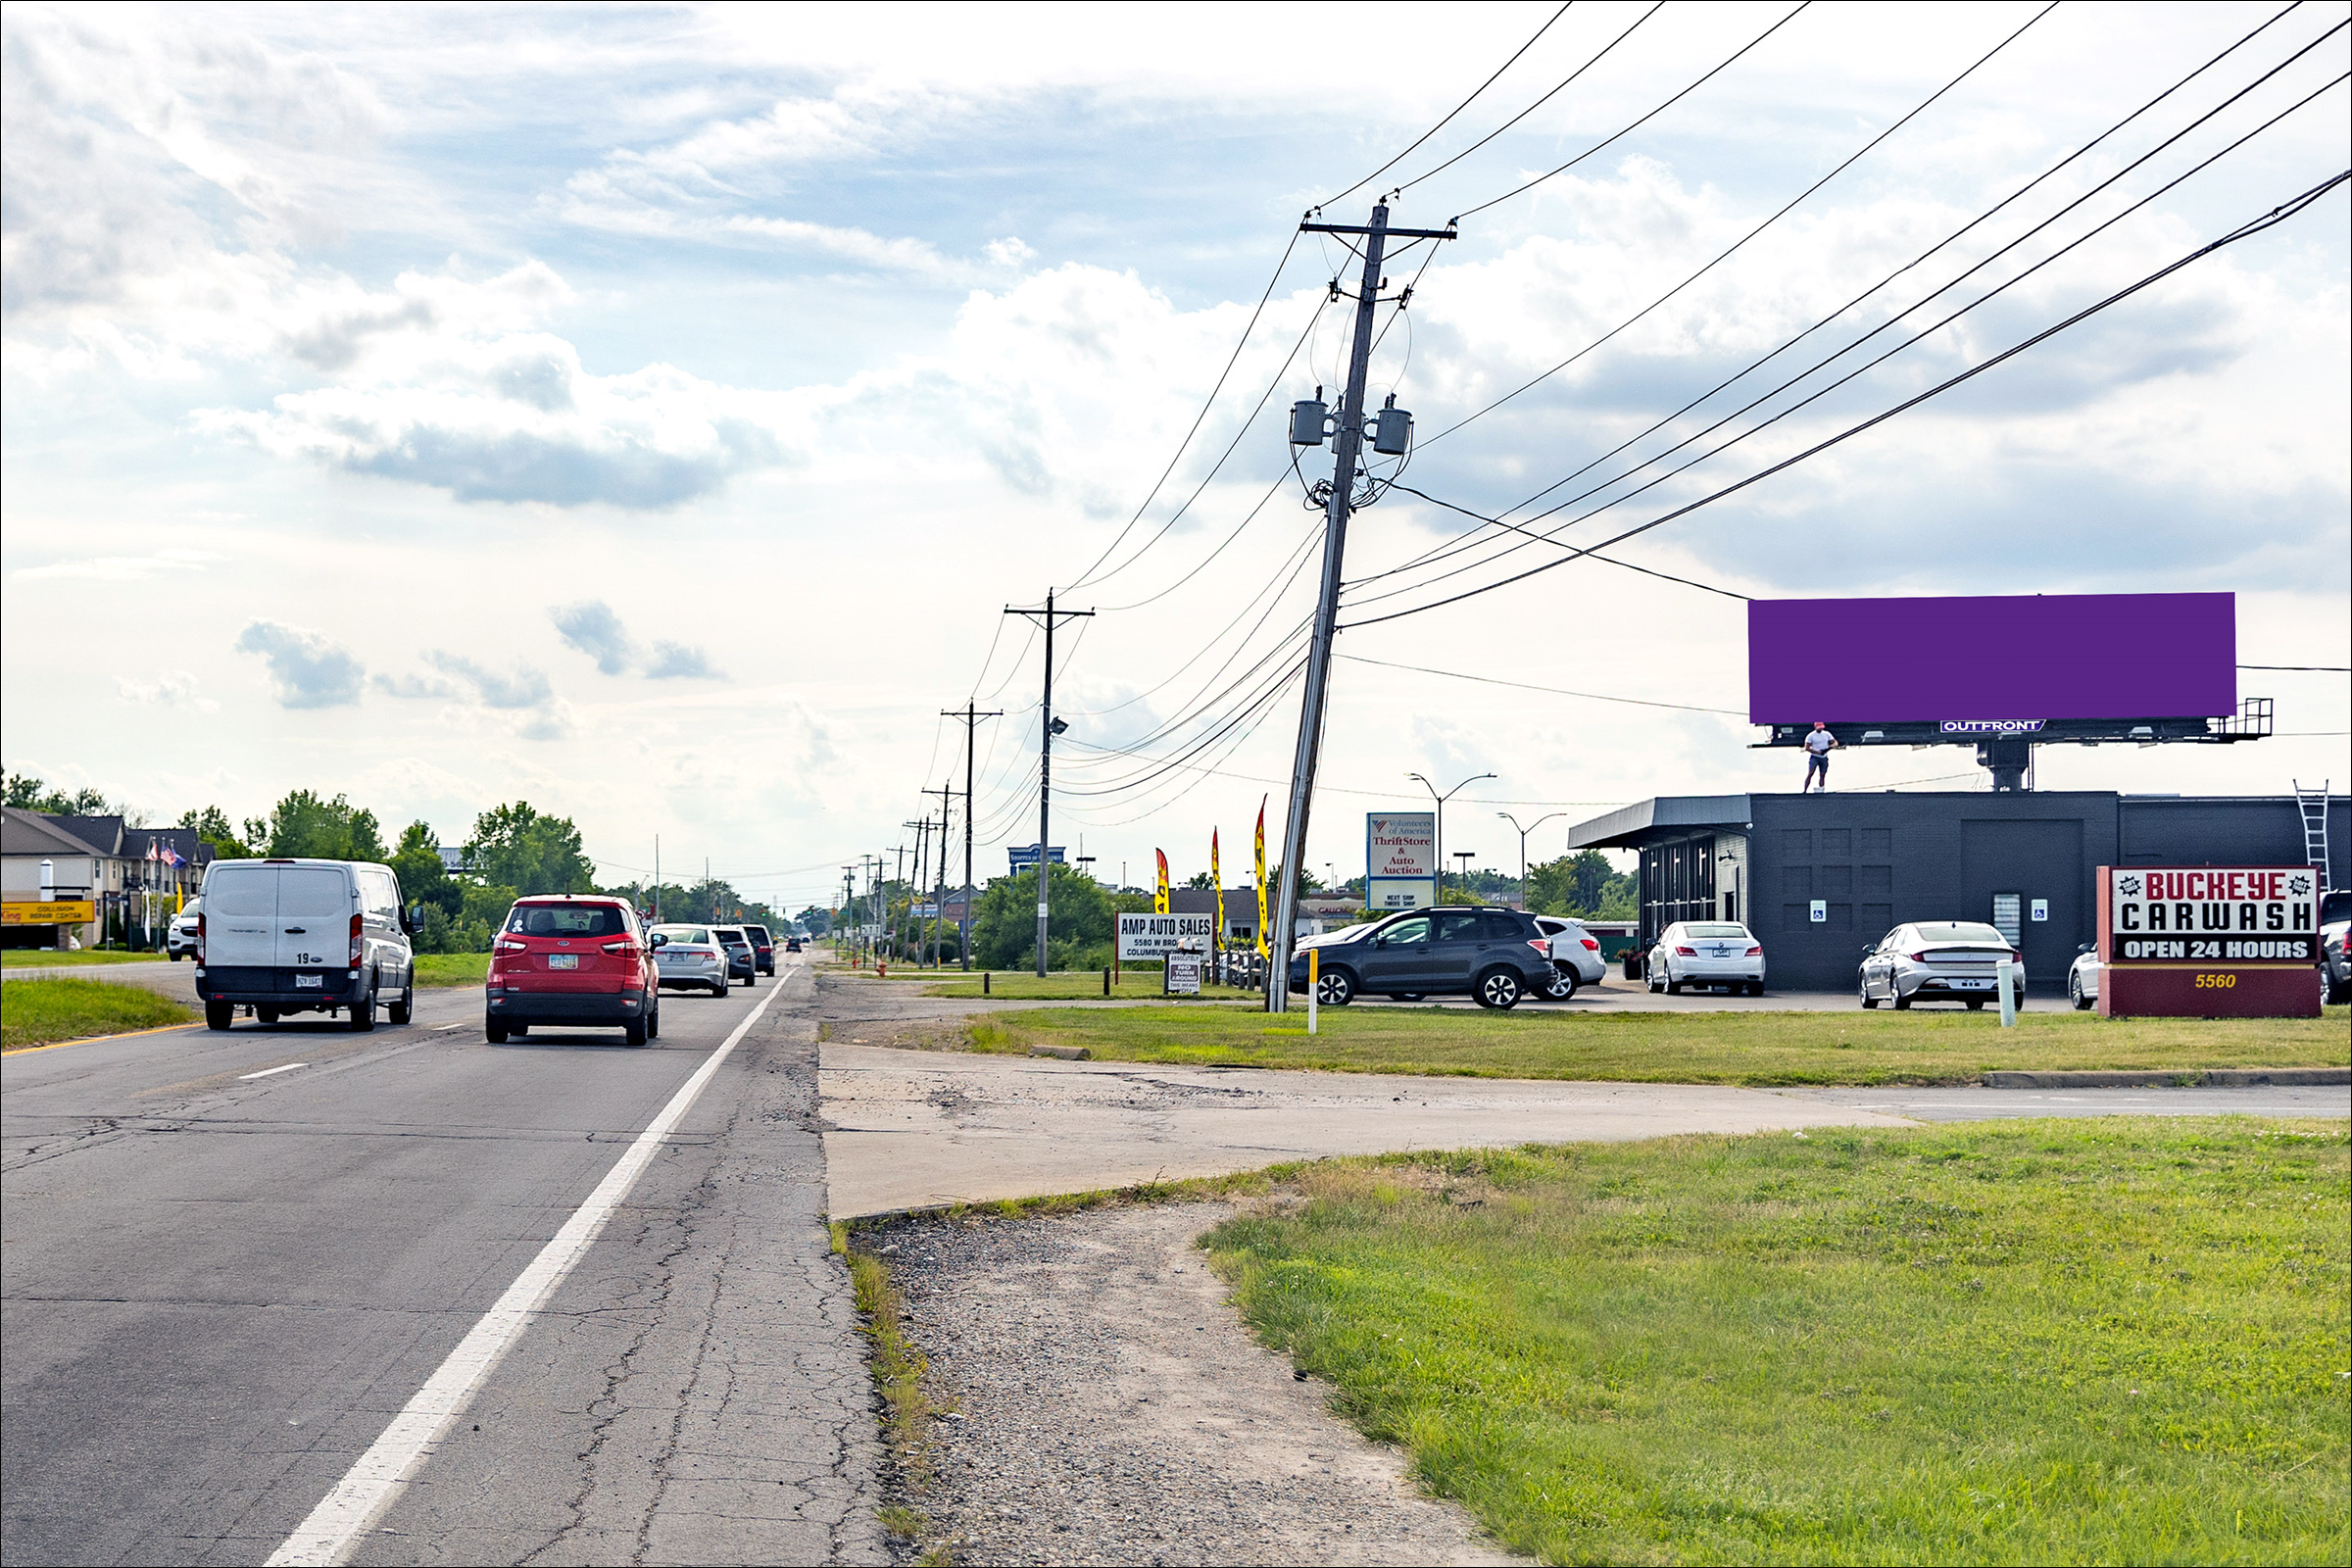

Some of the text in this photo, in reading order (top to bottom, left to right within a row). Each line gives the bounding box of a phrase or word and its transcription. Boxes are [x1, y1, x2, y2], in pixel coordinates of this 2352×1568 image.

[1944, 720, 2040, 731] OUTFRONT
[1389, 857, 1415, 865] Auto
[1382, 865, 1423, 874] Auction
[2146, 872, 2286, 901] BUCKEYE
[2122, 903, 2311, 930] CARWASH
[1121, 918, 1210, 935] AMP AUTO SALES
[2125, 940, 2308, 958] OPEN 24 HOURS
[297, 953, 309, 964] 19
[2195, 974, 2236, 989] 5560
